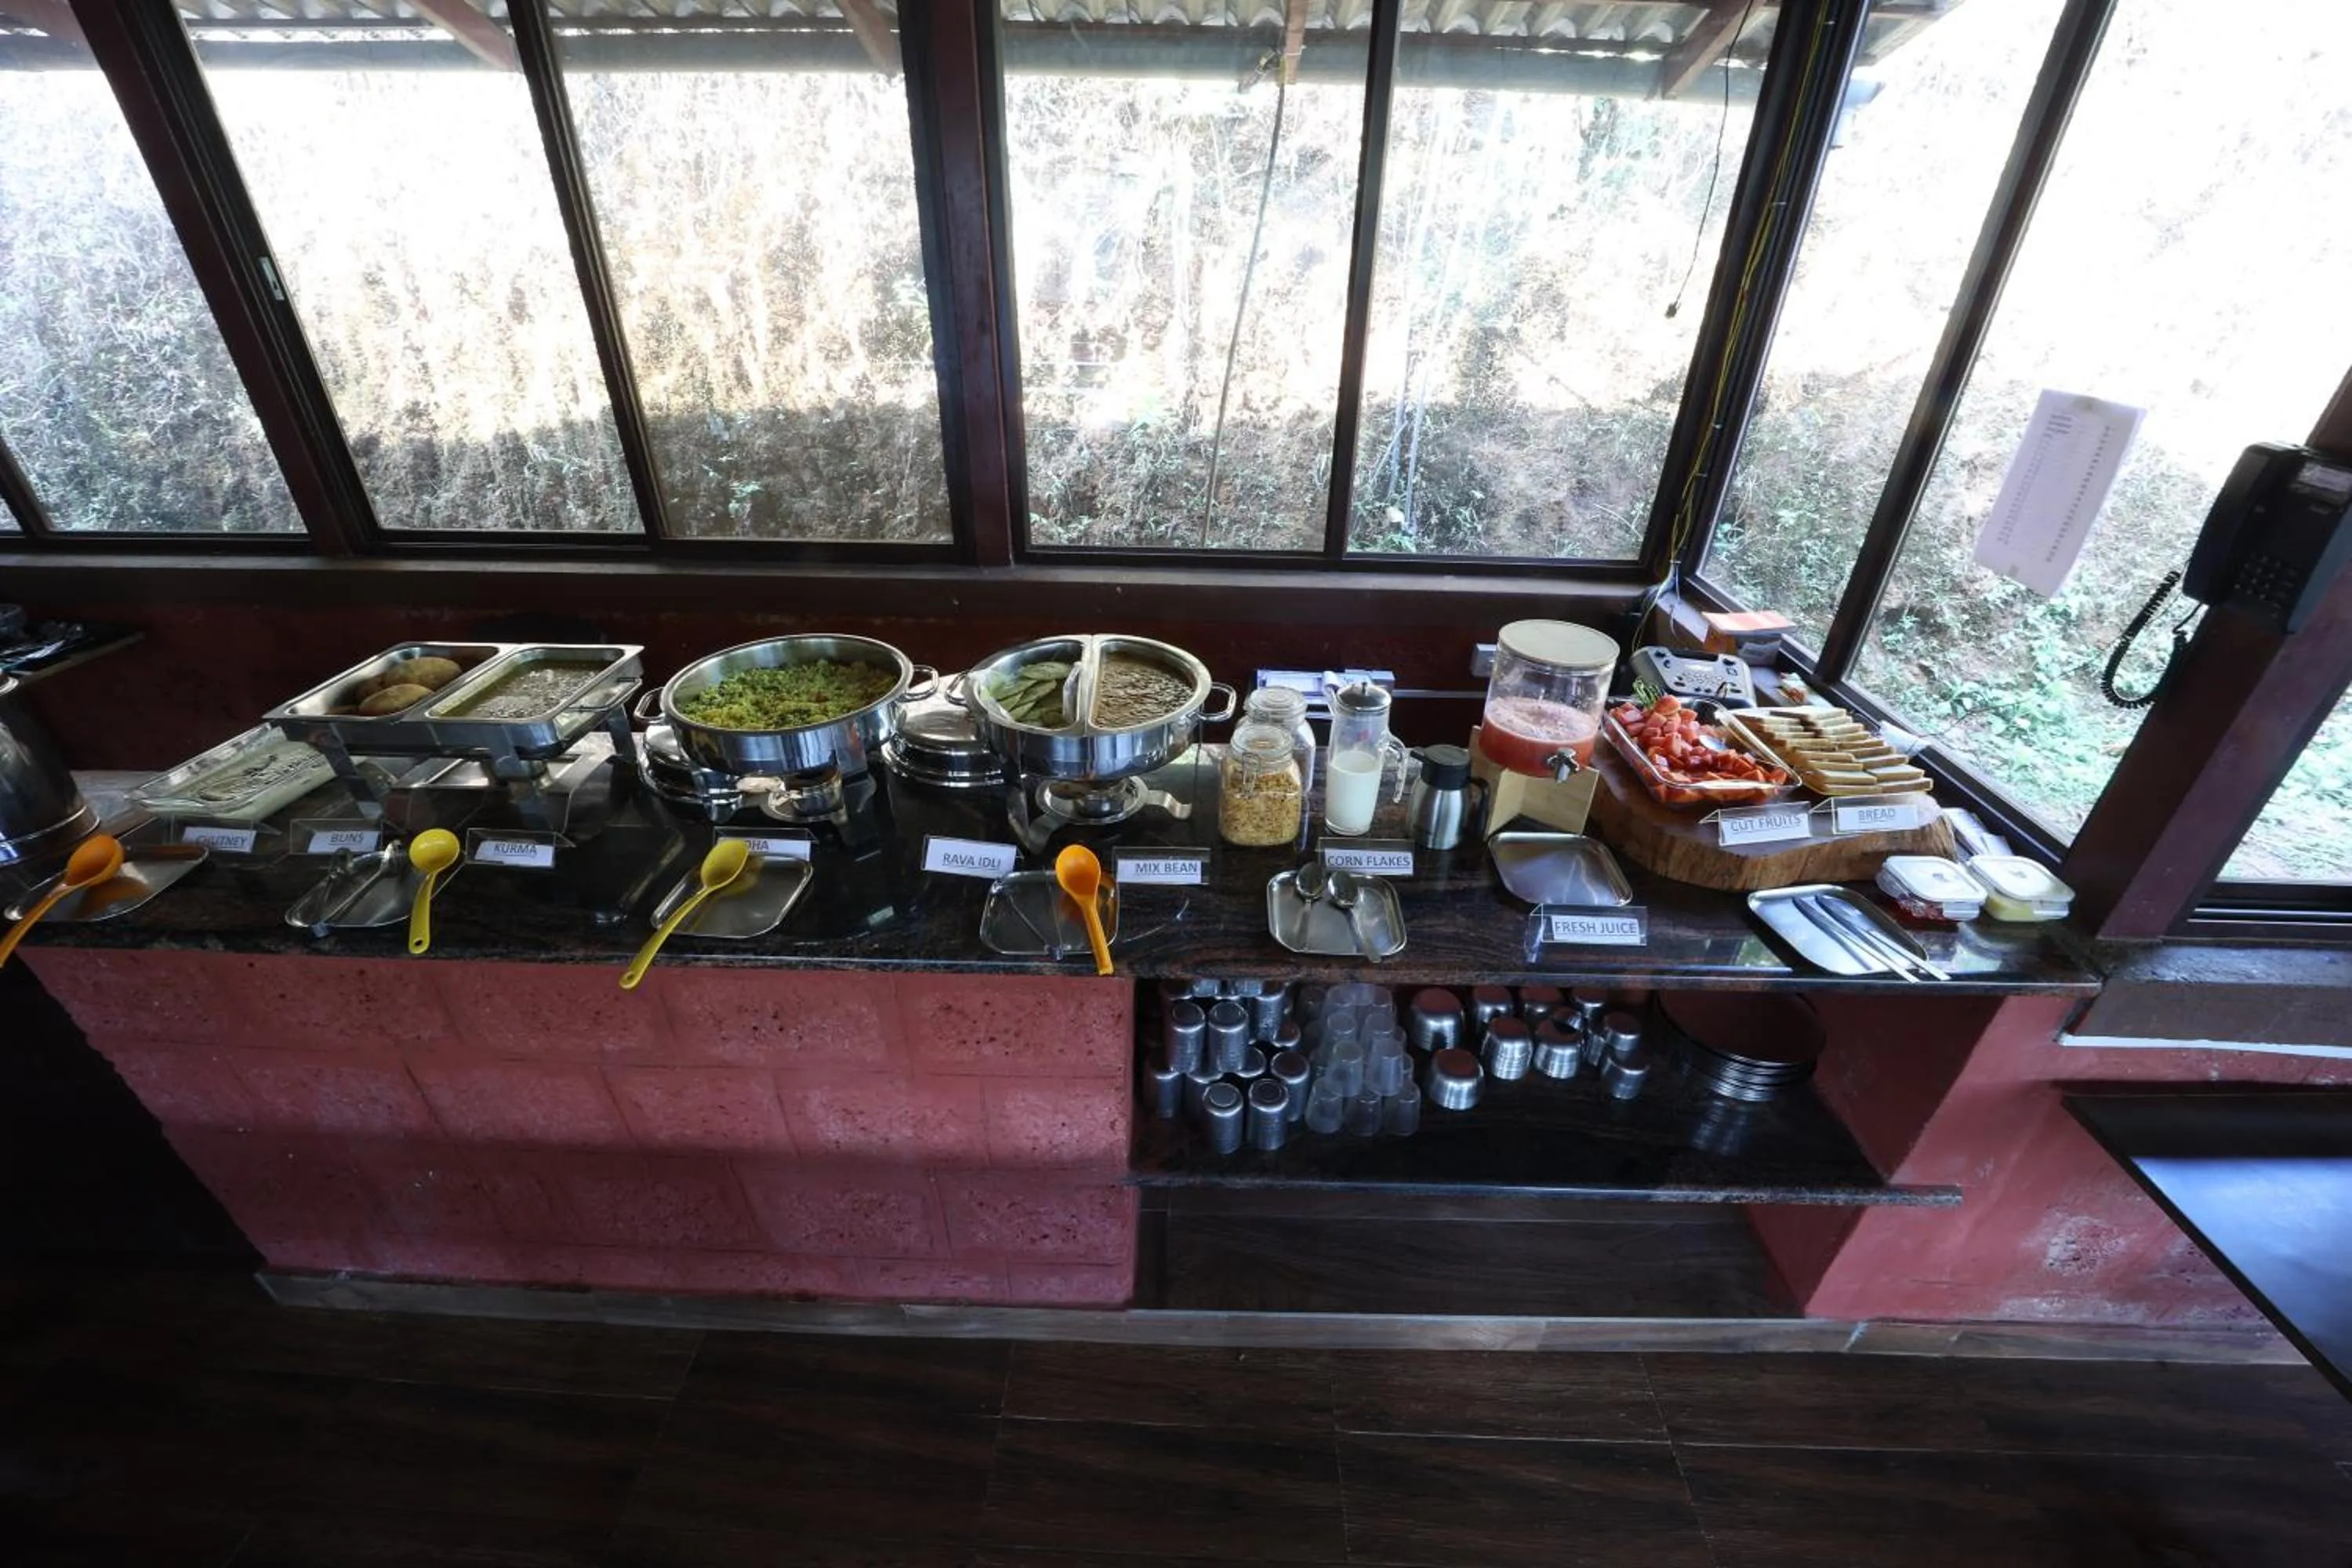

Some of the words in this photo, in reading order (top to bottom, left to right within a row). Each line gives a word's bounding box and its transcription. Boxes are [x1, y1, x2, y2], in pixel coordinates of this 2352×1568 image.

[1858, 808, 1896, 821] BREAD
[1731, 819, 1755, 832] CUT
[1759, 815, 1801, 829] FRUITS
[330, 833, 364, 844] BUNS
[494, 843, 538, 855] KURMA
[942, 852, 975, 866] RAVA
[978, 856, 1001, 869] IDLI
[1328, 855, 1363, 866] CORN
[1367, 856, 1411, 867] FLAKES
[1136, 863, 1160, 873] MIX
[1164, 862, 1197, 873] BEAN
[1555, 921, 1596, 933] FRESH
[1600, 923, 1638, 935] JUICE
